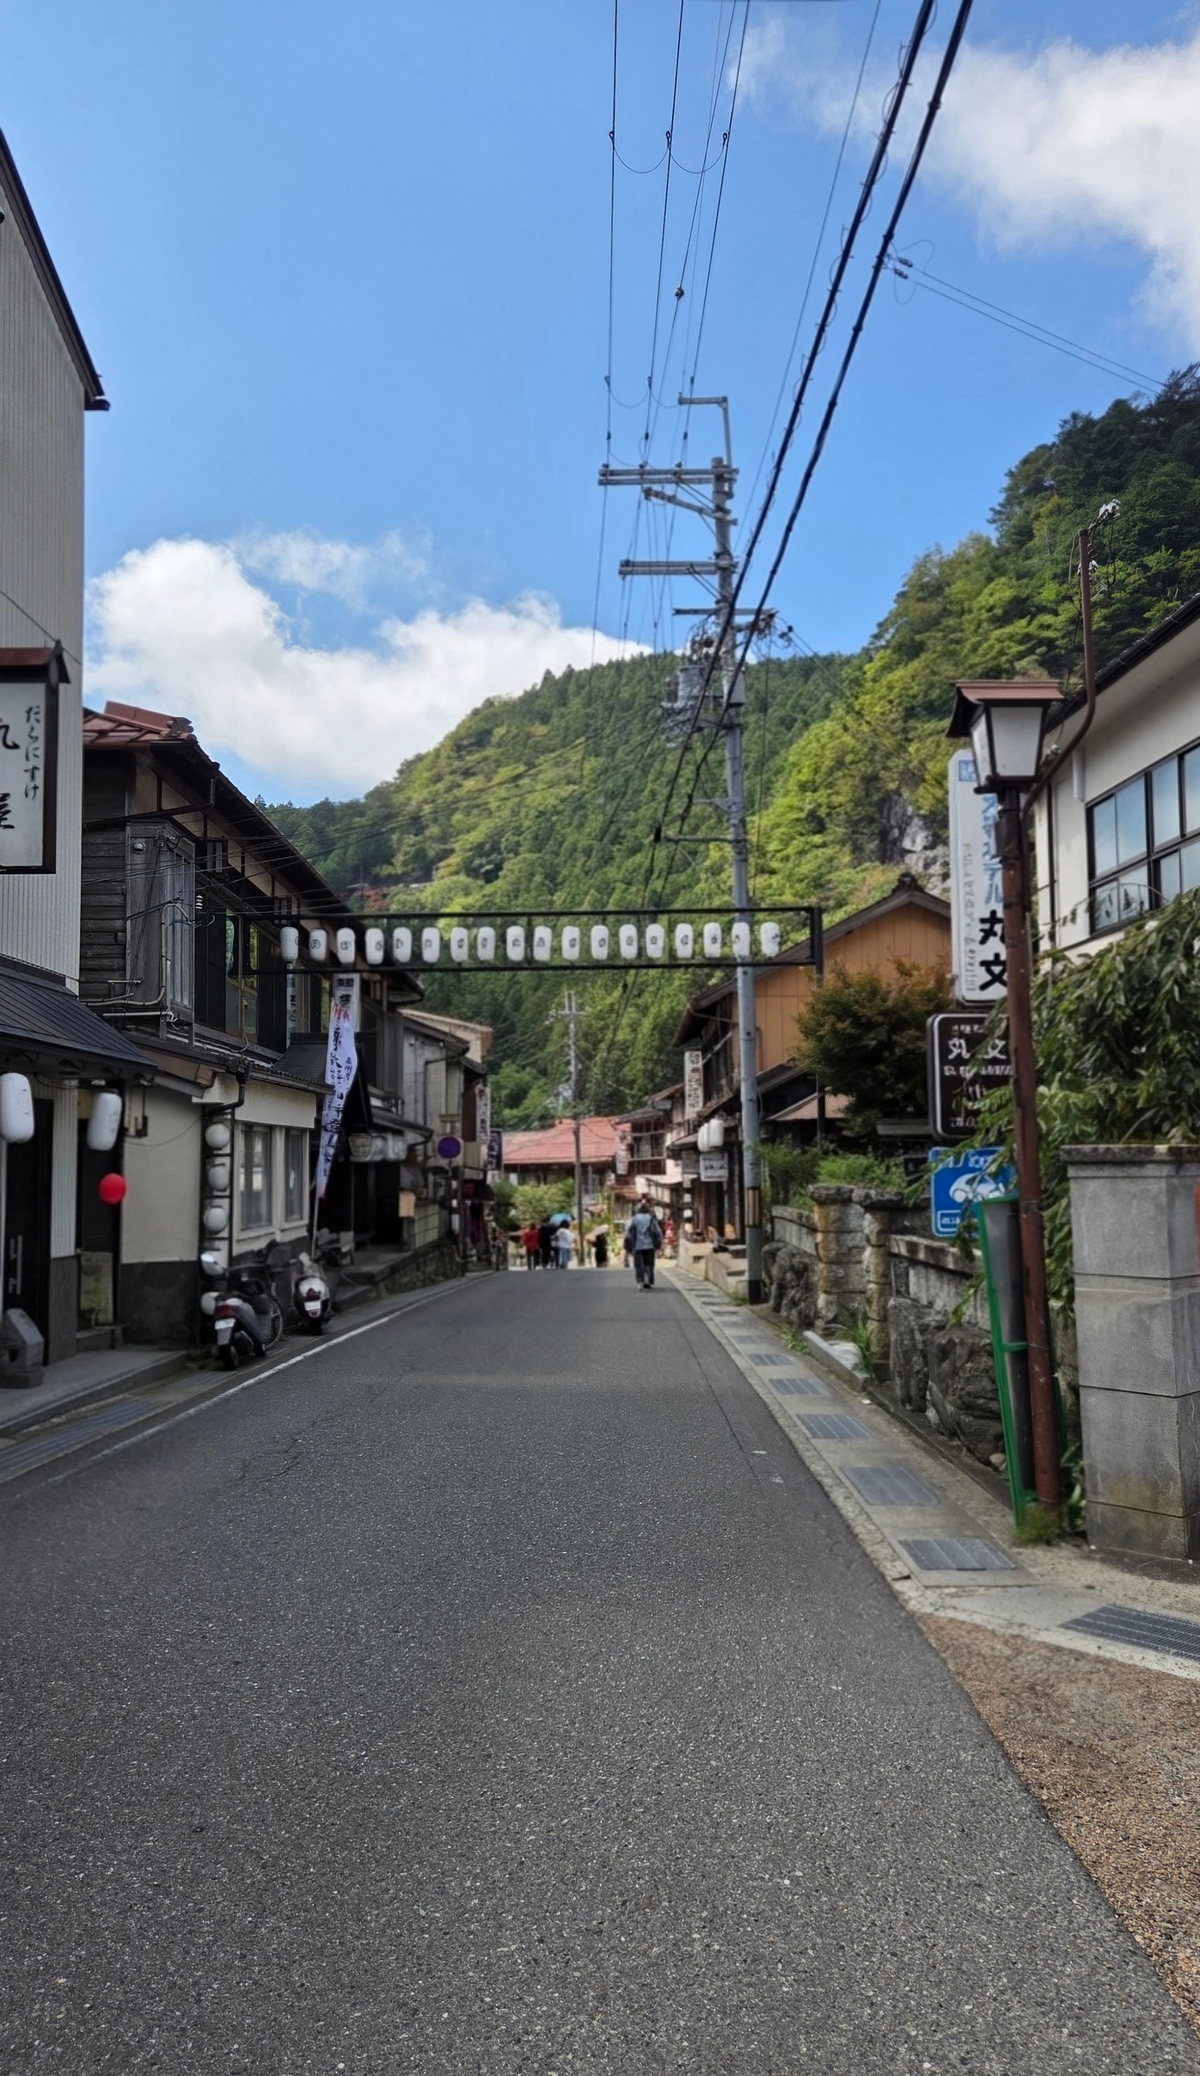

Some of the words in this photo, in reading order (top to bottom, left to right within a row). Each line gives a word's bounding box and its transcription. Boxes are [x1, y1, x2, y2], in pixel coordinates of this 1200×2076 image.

[23, 704, 41, 800] だらにすけ
[978, 909, 1008, 992] 丸文
